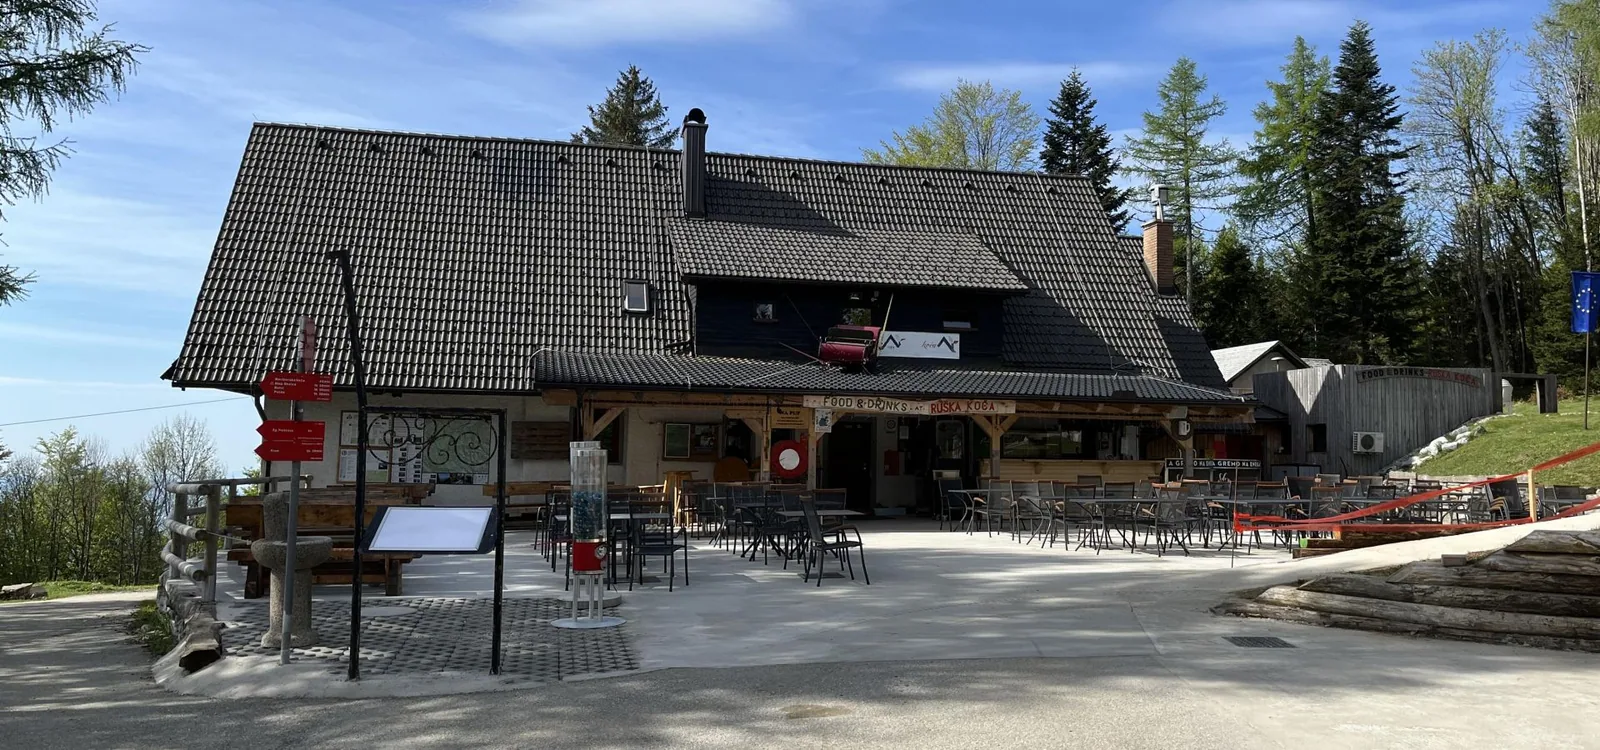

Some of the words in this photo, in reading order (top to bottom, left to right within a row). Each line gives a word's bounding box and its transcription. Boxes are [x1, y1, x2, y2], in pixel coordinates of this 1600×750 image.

[1361, 369, 1384, 380] FOOD
[1393, 367, 1424, 377] DRINKS
[823, 396, 853, 408] FOOD
[867, 397, 908, 412] DRINKS
[931, 399, 961, 414] RUŠKA
[966, 399, 996, 411] KOČA
